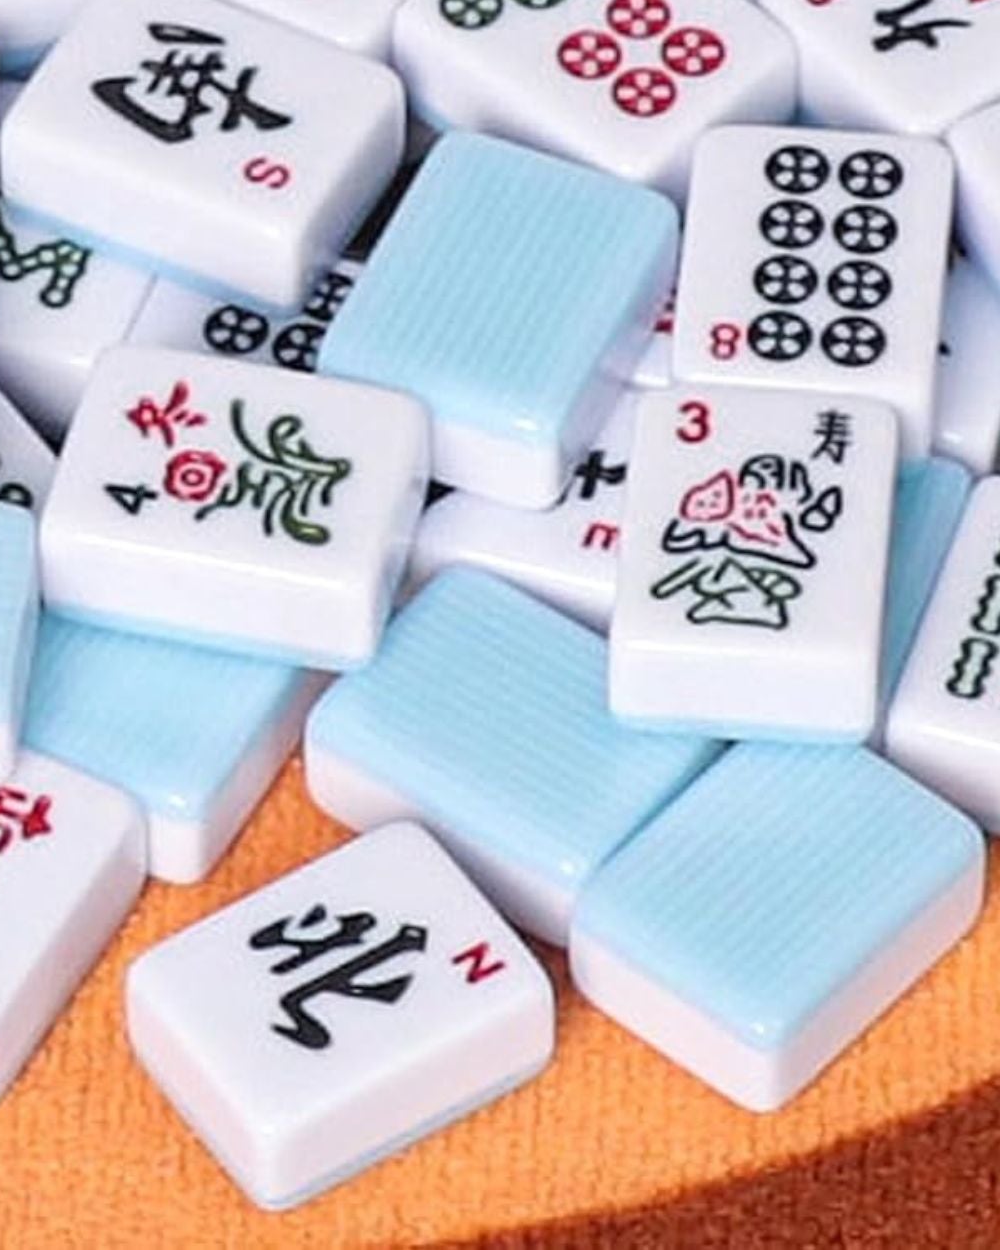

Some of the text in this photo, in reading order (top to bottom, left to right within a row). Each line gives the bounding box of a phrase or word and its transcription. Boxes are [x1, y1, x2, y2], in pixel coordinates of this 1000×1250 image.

[90, 22, 294, 144] 南
[243, 157, 290, 189] S
[710, 323, 742, 360] 8
[125, 381, 207, 449] 冬
[676, 401, 711, 444] 3
[810, 410, 851, 465] 寿
[103, 483, 160, 515] 4
[248, 904, 428, 1051] 北
[451, 942, 506, 984] N
